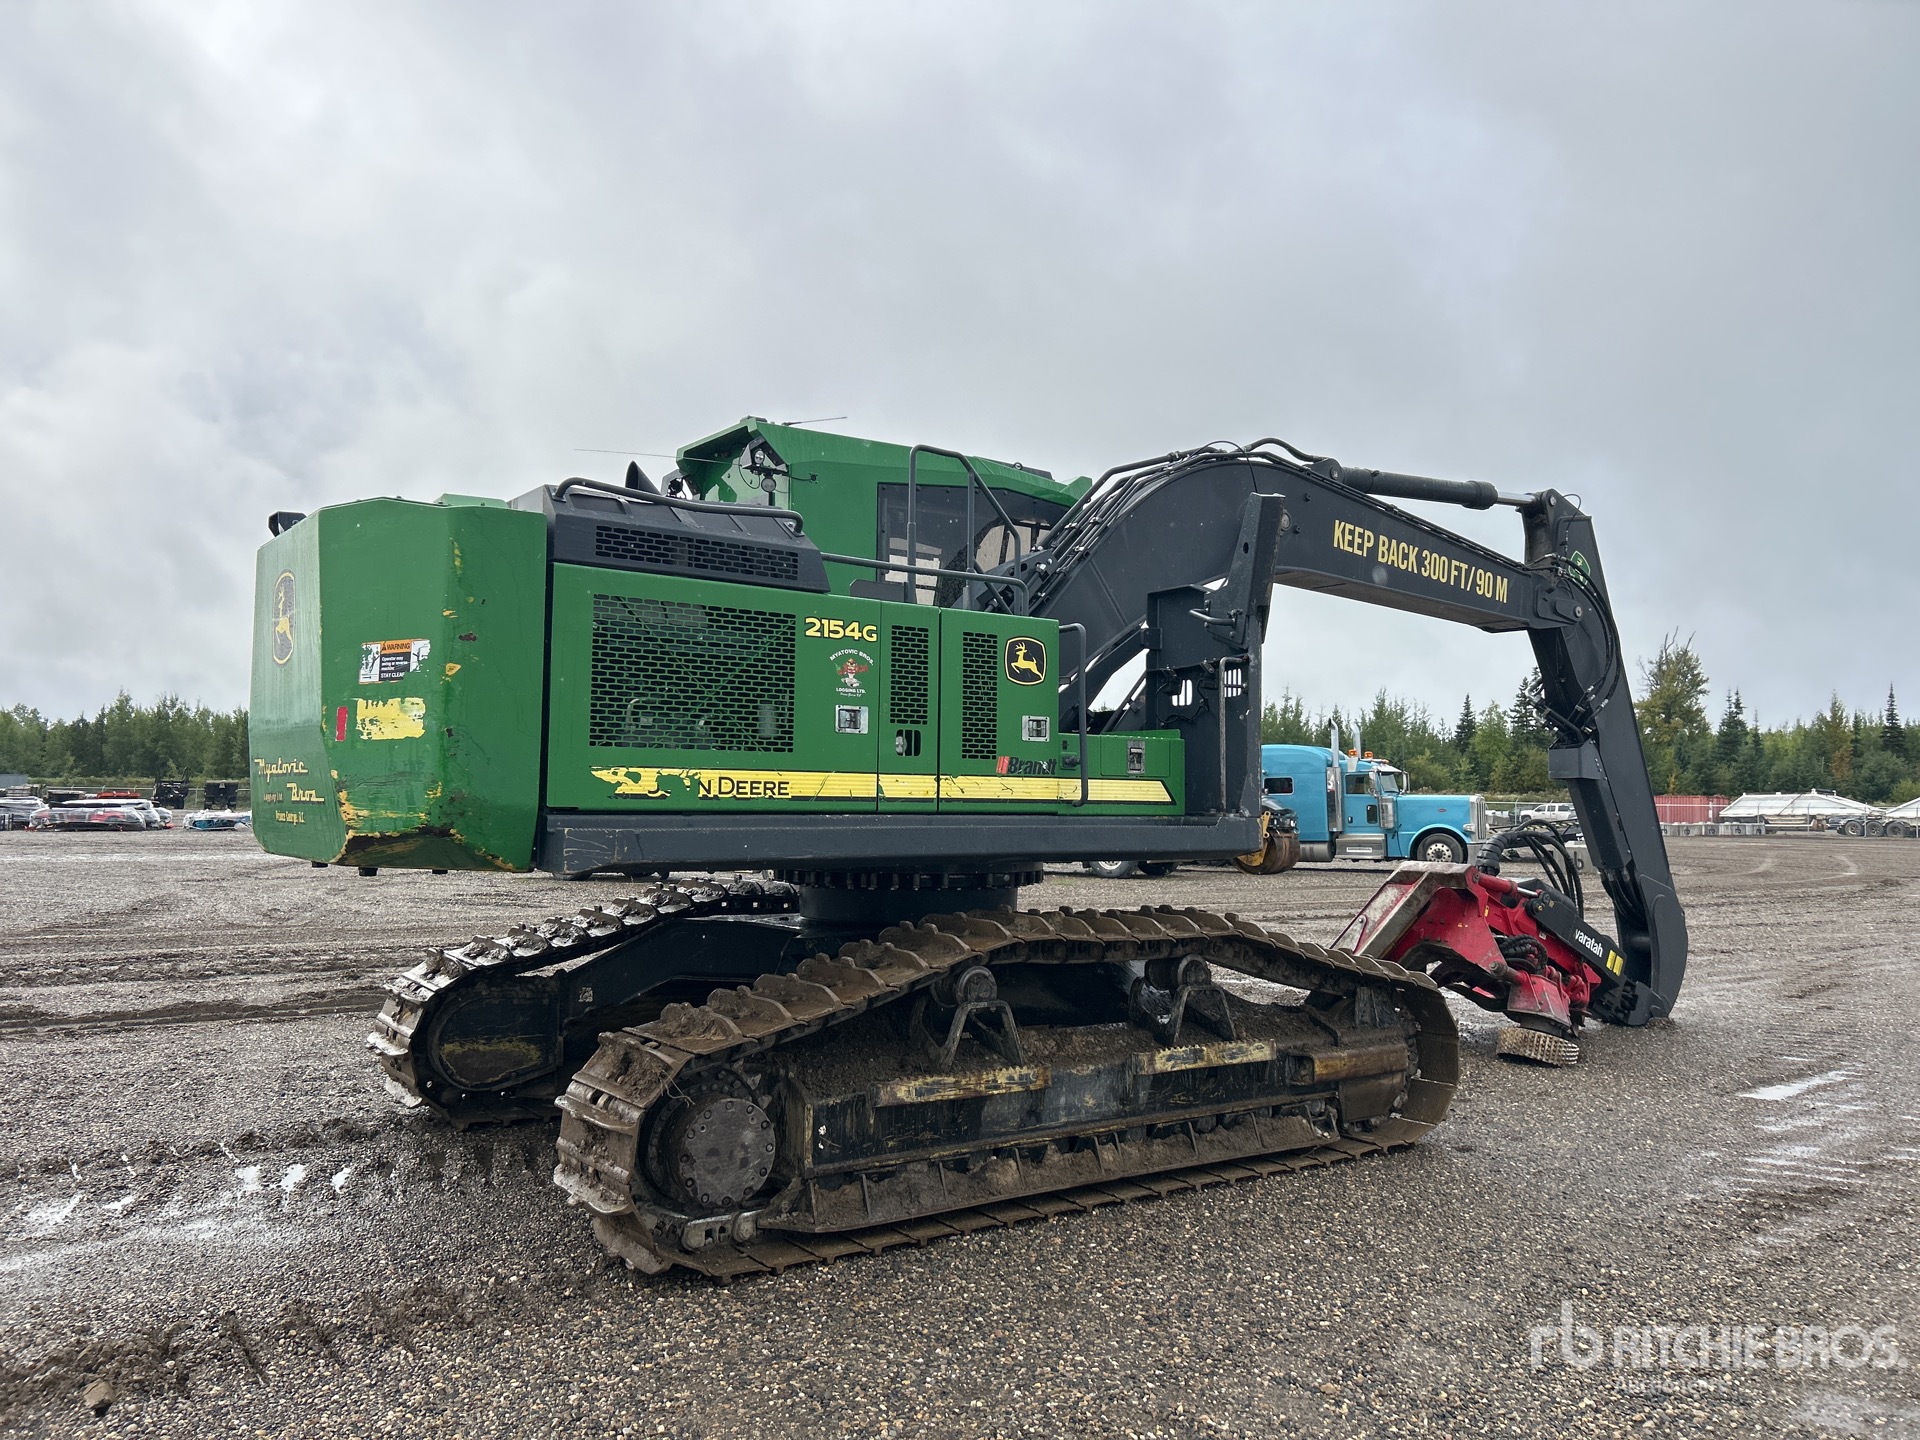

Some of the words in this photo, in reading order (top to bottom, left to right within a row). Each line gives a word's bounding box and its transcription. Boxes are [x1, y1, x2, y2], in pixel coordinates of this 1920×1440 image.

[1333, 519, 1374, 557] KEEP
[1377, 534, 1419, 574] BACK
[1421, 549, 1448, 583] 300
[1496, 575, 1508, 604] M
[804, 616, 878, 642] 2154G
[386, 642, 411, 650] WARNING
[829, 648, 858, 661] MYATOVIC
[254, 757, 309, 783] Myatovic
[718, 776, 790, 797] DEERE
